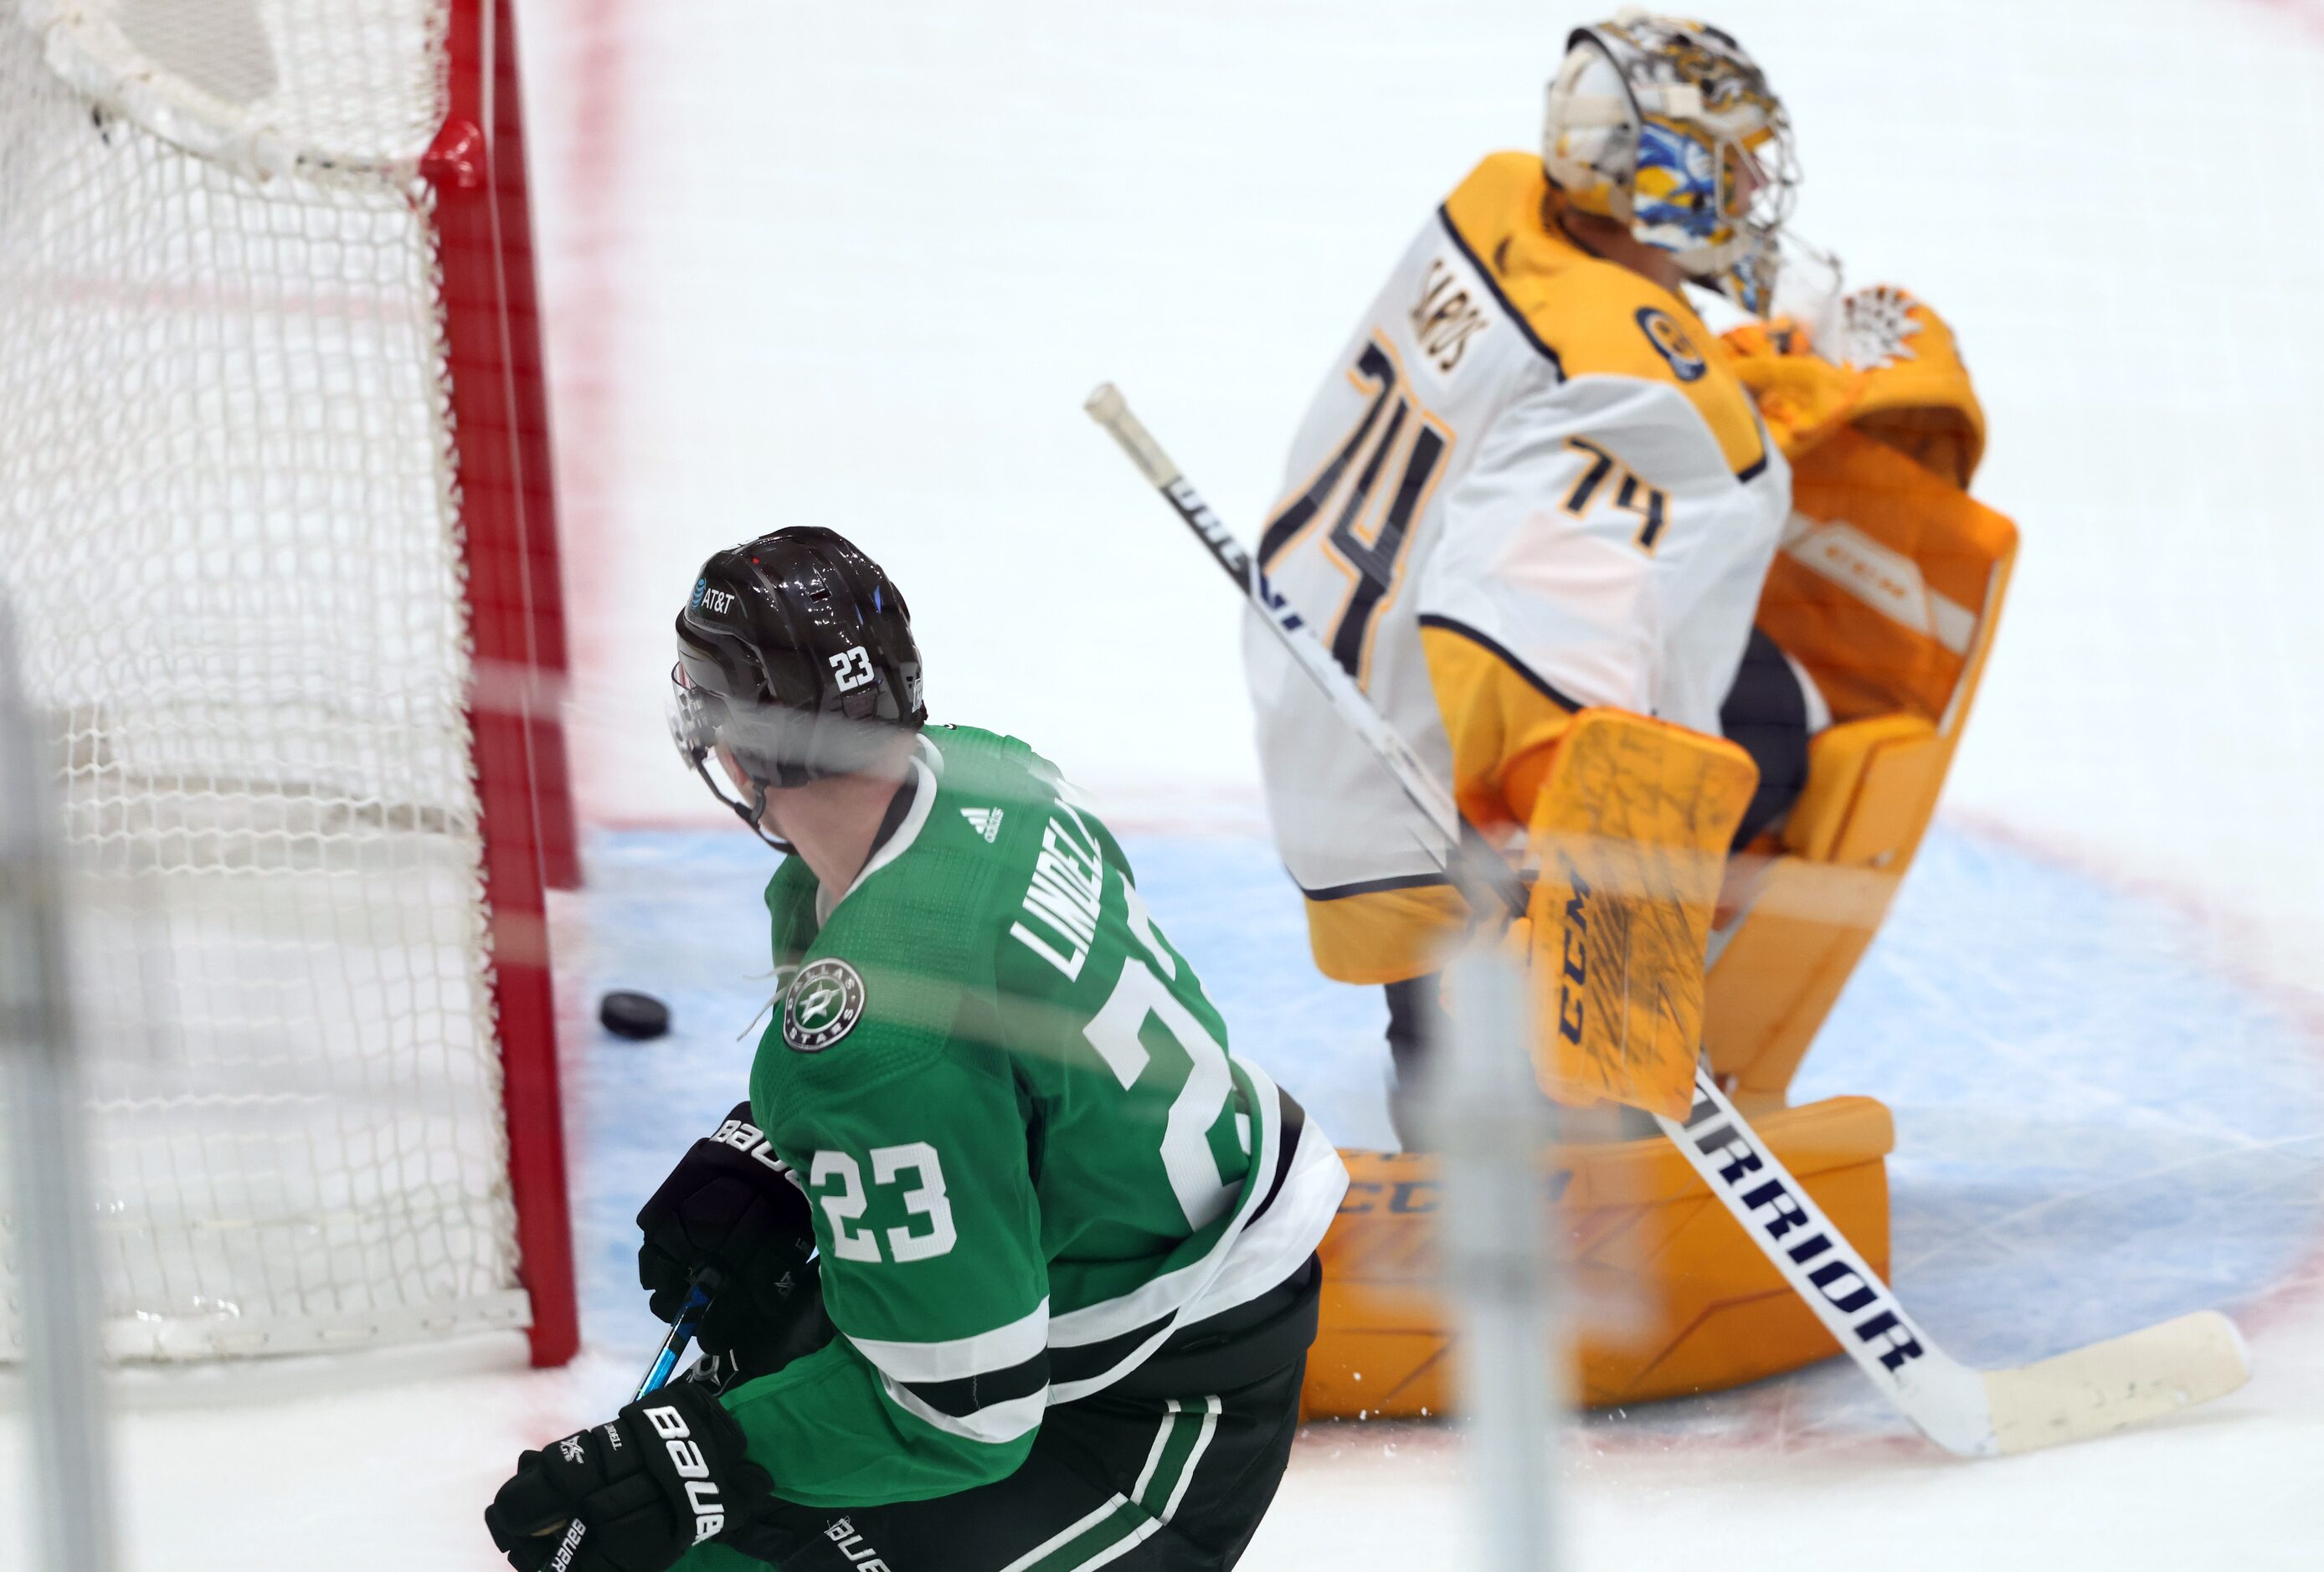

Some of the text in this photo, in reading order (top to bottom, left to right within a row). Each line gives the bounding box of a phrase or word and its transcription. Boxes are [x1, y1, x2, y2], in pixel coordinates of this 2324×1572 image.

[1254, 326, 1457, 695] 74
[1560, 434, 1671, 557] 74
[702, 588, 735, 614] AT&T
[829, 645, 876, 693] 23
[1559, 847, 1591, 1045] CCM
[789, 1008, 854, 1045] STARS
[810, 1141, 958, 1264] 23
